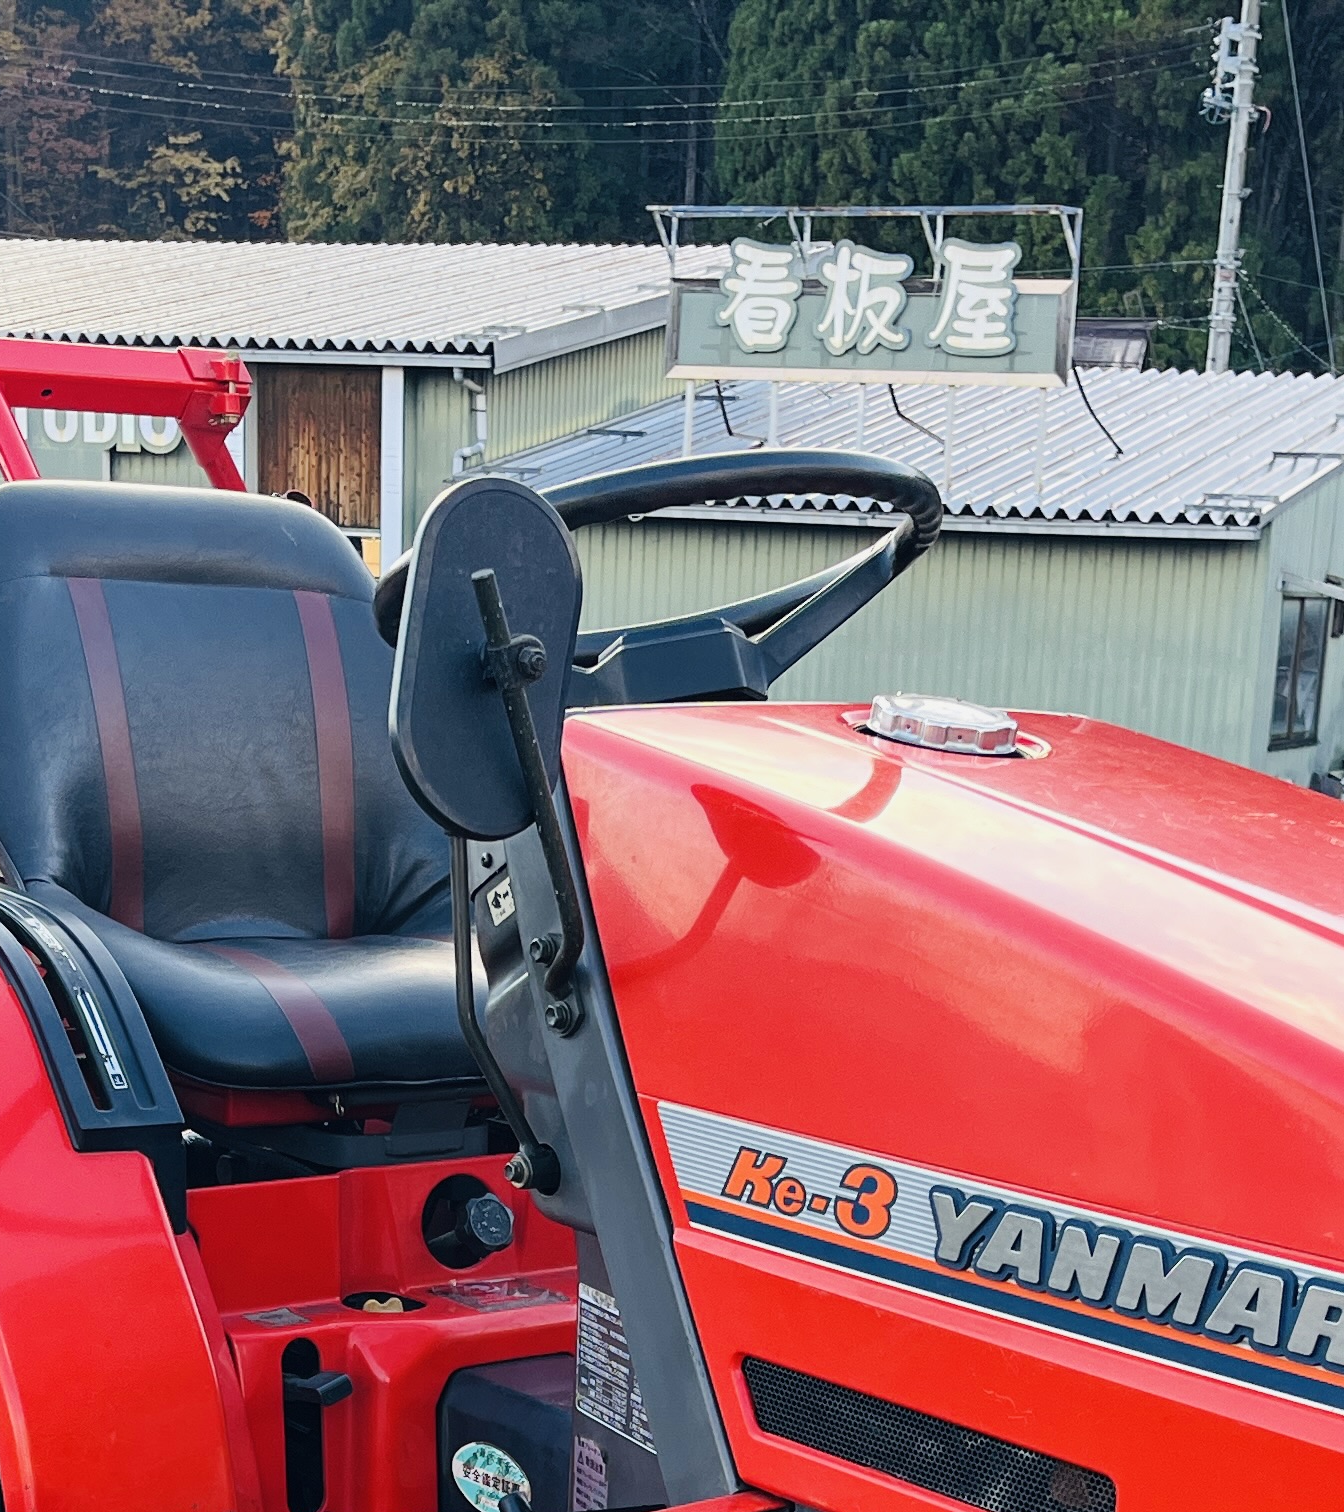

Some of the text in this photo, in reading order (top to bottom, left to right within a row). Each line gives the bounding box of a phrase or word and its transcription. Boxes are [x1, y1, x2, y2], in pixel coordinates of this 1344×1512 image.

[718, 242, 1017, 353] 看板屋
[721, 1145, 899, 1240] Ke-3
